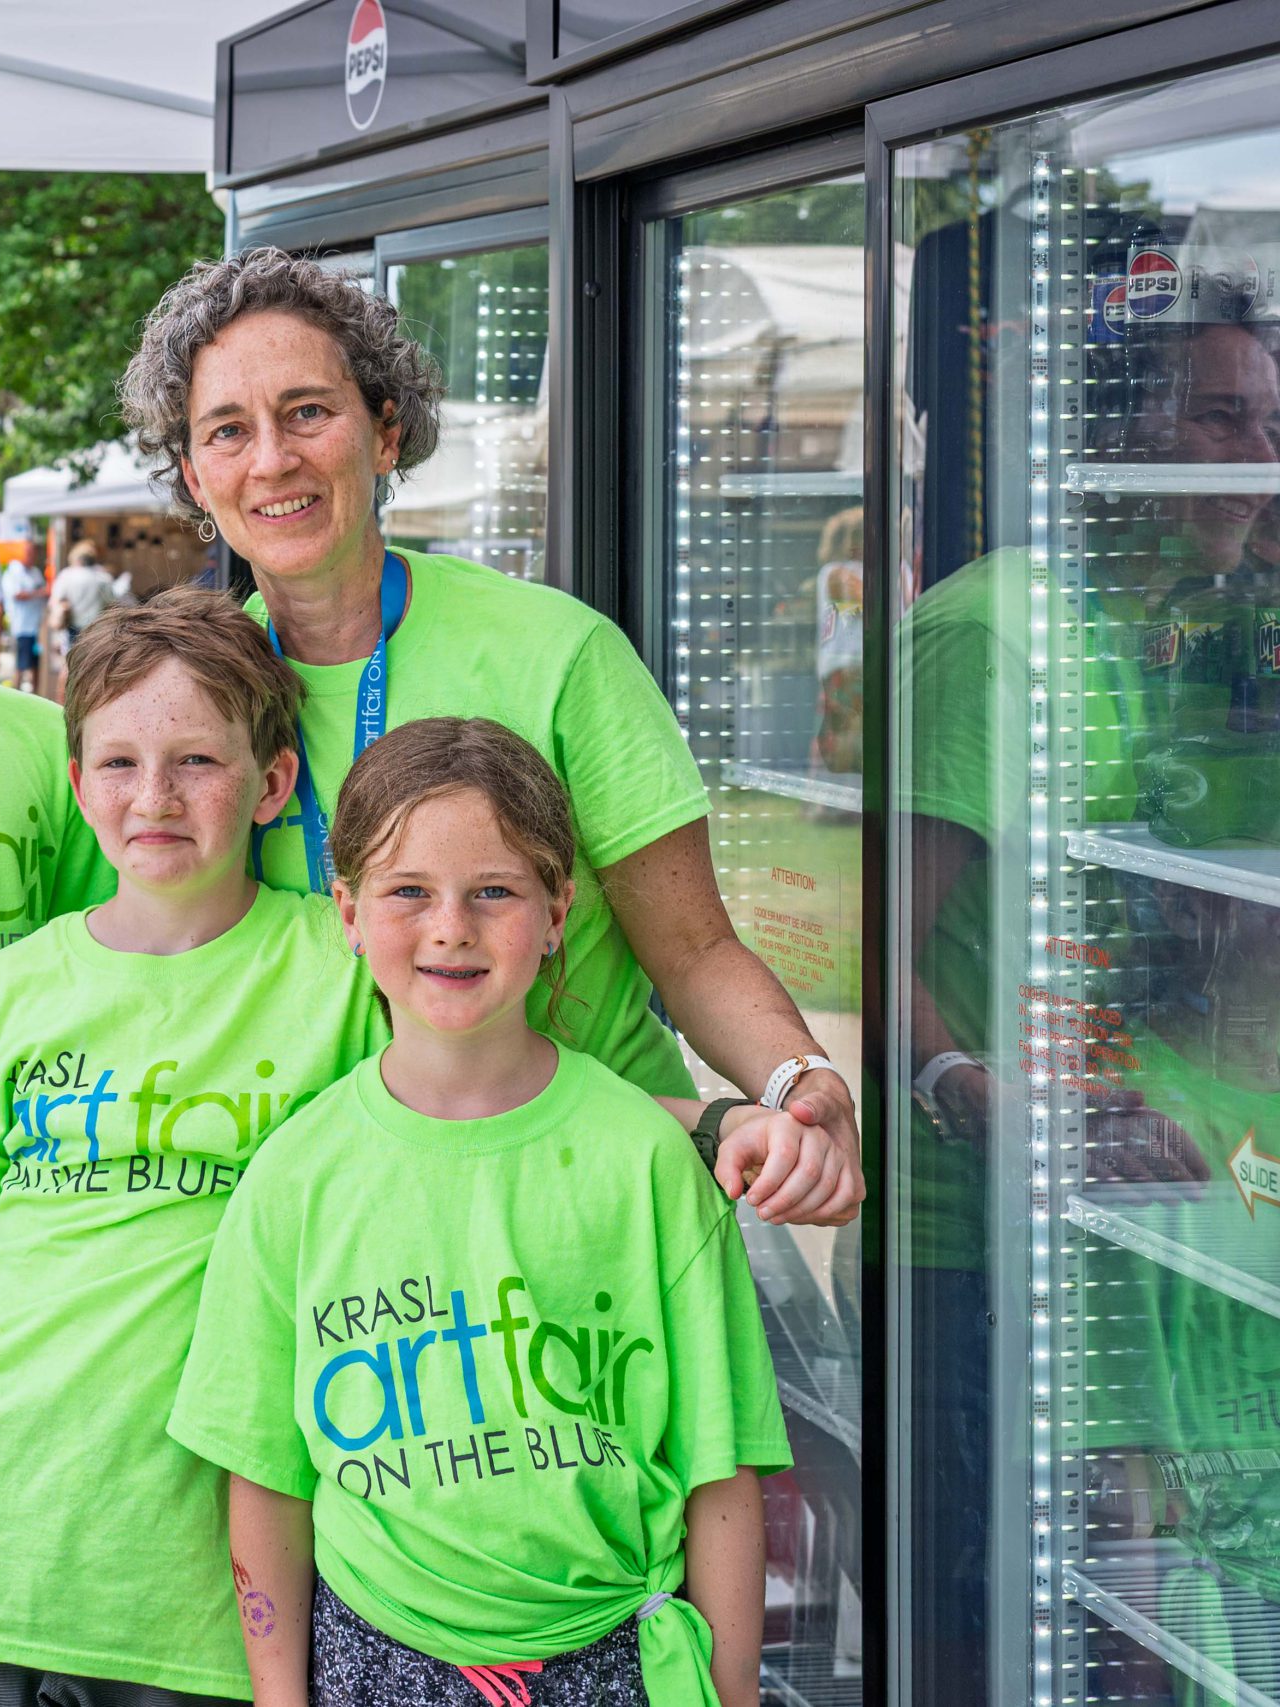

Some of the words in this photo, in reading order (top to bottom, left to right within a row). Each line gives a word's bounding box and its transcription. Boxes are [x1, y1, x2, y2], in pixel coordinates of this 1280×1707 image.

[348, 42, 384, 80] PEPSI
[361, 685, 381, 717] fair
[771, 867, 817, 892] ATTENTION:
[791, 918, 800, 929] BE
[817, 940, 830, 953] FOR
[1018, 984, 1049, 1001] COOLER
[1075, 1000, 1087, 1015] BE
[1089, 1004, 1123, 1026] PLACED
[1018, 1002, 1027, 1016] IN
[1031, 1006, 1066, 1028] UPRIGHT
[1070, 1017, 1109, 1041] POSITION
[1113, 1031, 1133, 1048] FOR
[1018, 1039, 1052, 1061] FAILURE
[1055, 1052, 1067, 1066] TO
[1086, 1061, 1099, 1075] SO
[1077, 1039, 1088, 1053] TO
[1019, 1058, 1038, 1075] VOID
[126, 1154, 246, 1196] BLUF
[1240, 1160, 1278, 1194] SLIDE
[313, 1275, 448, 1347] KRASL
[313, 1290, 488, 1452] art
[490, 1276, 655, 1427] fair
[337, 1448, 411, 1500] ON
[424, 1430, 515, 1488] THE
[524, 1422, 626, 1472] BLUFF
